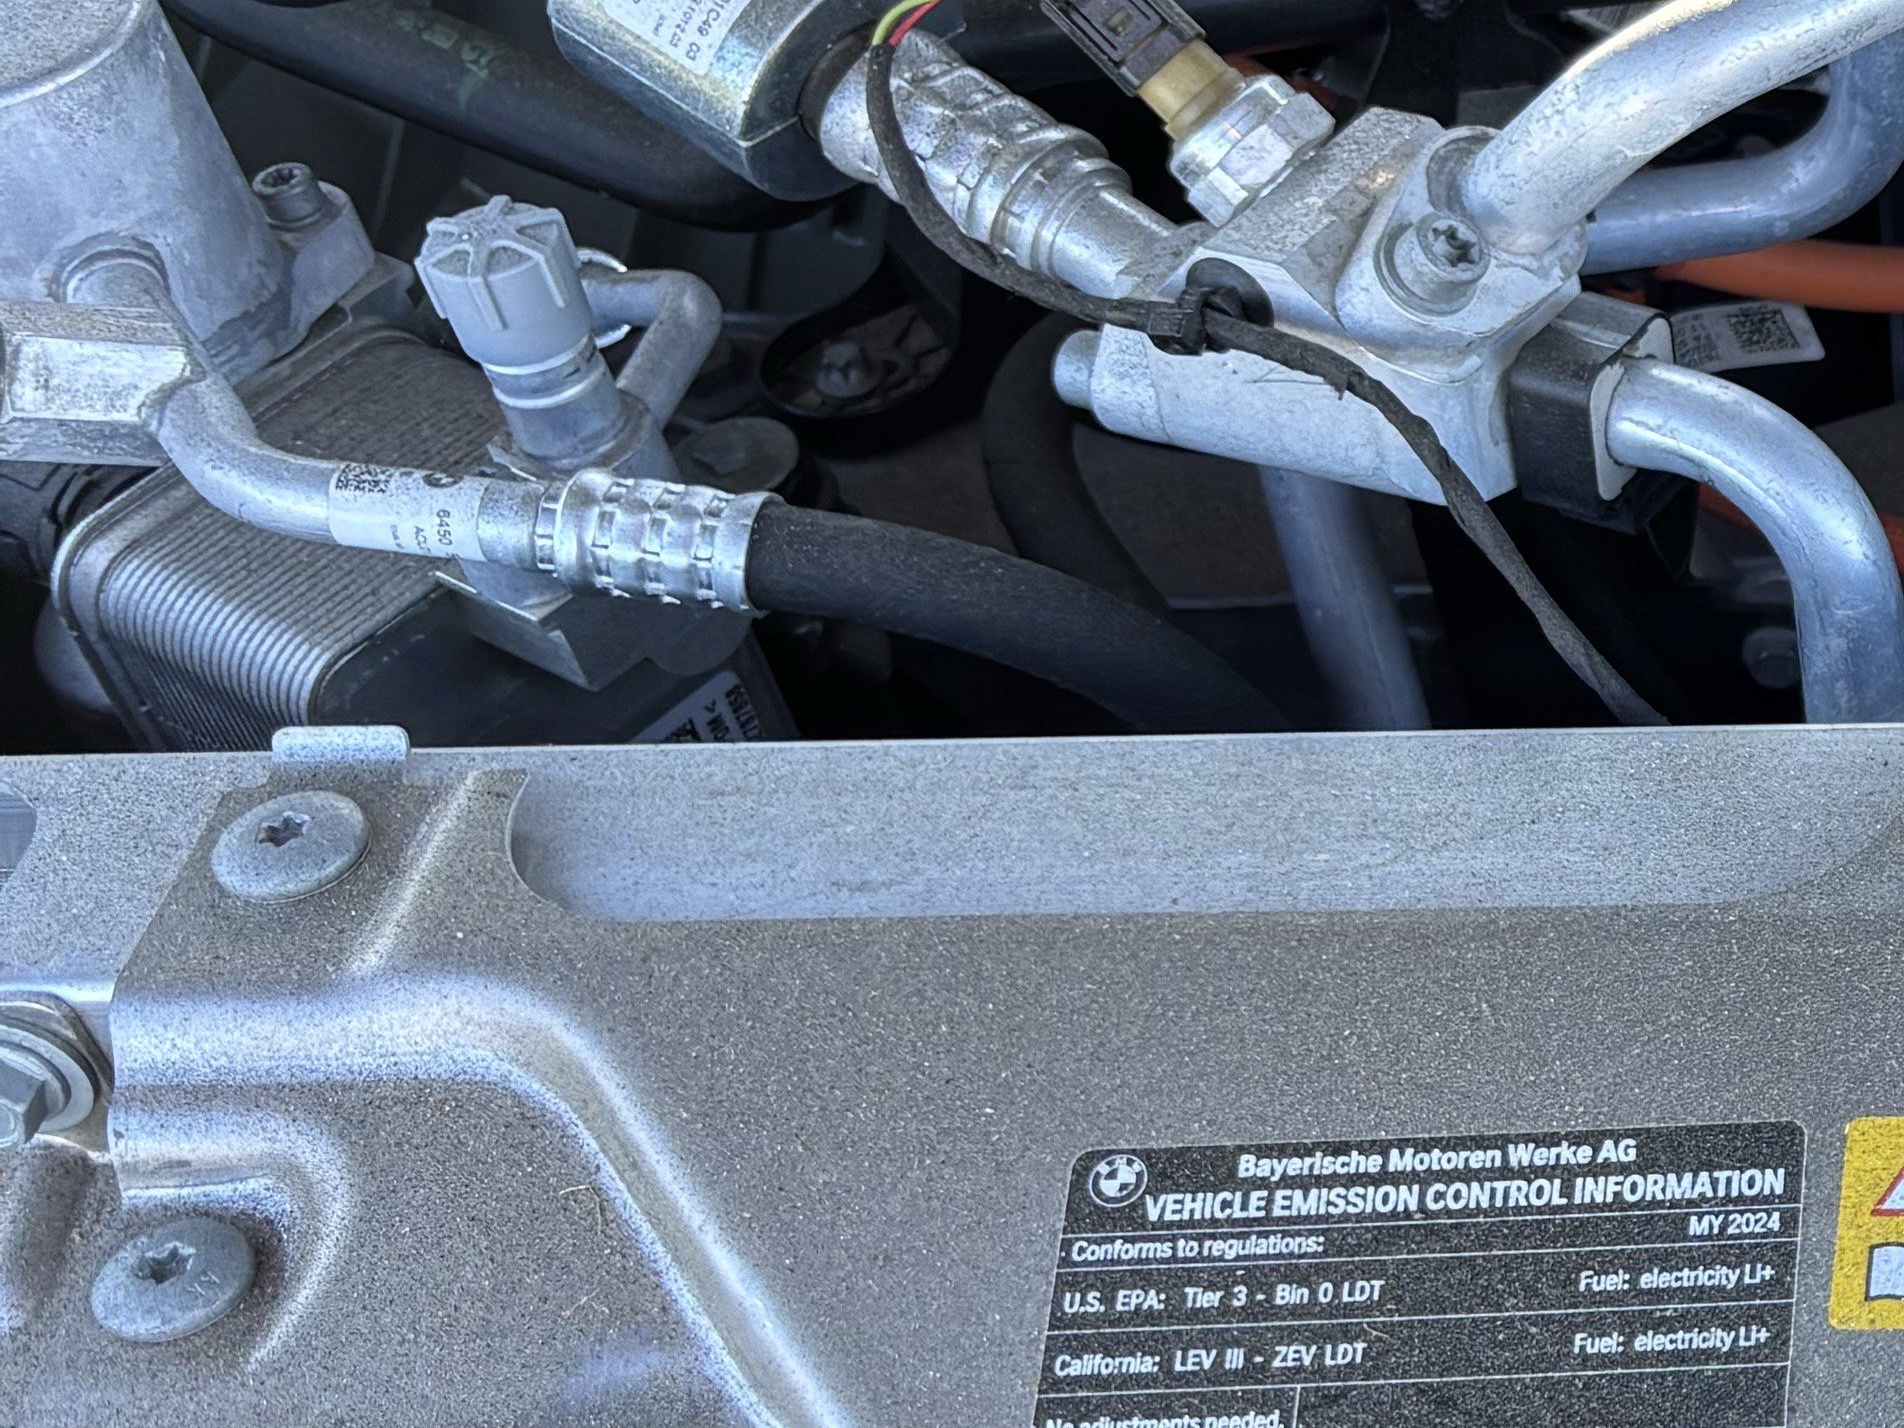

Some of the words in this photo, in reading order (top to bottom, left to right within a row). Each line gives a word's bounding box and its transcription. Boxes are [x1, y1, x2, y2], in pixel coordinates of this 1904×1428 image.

[1236, 1152, 1383, 1181] Bayerische
[1388, 1145, 1502, 1173] Motoren
[1508, 1140, 1592, 1170] Werke
[1597, 1138, 1638, 1163] AG
[1144, 1189, 1269, 1223] VEHICLE
[1272, 1184, 1420, 1218] EMISSION
[1425, 1179, 1569, 1211] CONTROL
[1574, 1167, 1786, 1205] INFORMATION
[1688, 1214, 1725, 1237] MY
[1726, 1211, 1782, 1235] 2024
[1071, 1239, 1174, 1263] Conforms
[1177, 1239, 1199, 1259] to
[1203, 1234, 1325, 1260] regulations:
[1578, 1270, 1632, 1293] Fuel:
[1639, 1266, 1741, 1291] electricity
[1063, 1291, 1106, 1315] U.S.
[1115, 1288, 1167, 1313] EPA:
[1183, 1286, 1225, 1309] Tier
[1231, 1286, 1248, 1308] 3
[1275, 1283, 1310, 1306] Bin
[1317, 1281, 1334, 1305] 0
[1341, 1279, 1386, 1304] LDT
[1573, 1332, 1625, 1355] Fuel:
[1633, 1327, 1735, 1354] electricity
[1054, 1353, 1160, 1378] California:
[1174, 1348, 1217, 1372] LEV
[1224, 1348, 1246, 1370] III
[1271, 1344, 1318, 1369] ZEV
[1324, 1342, 1369, 1367] LDT
